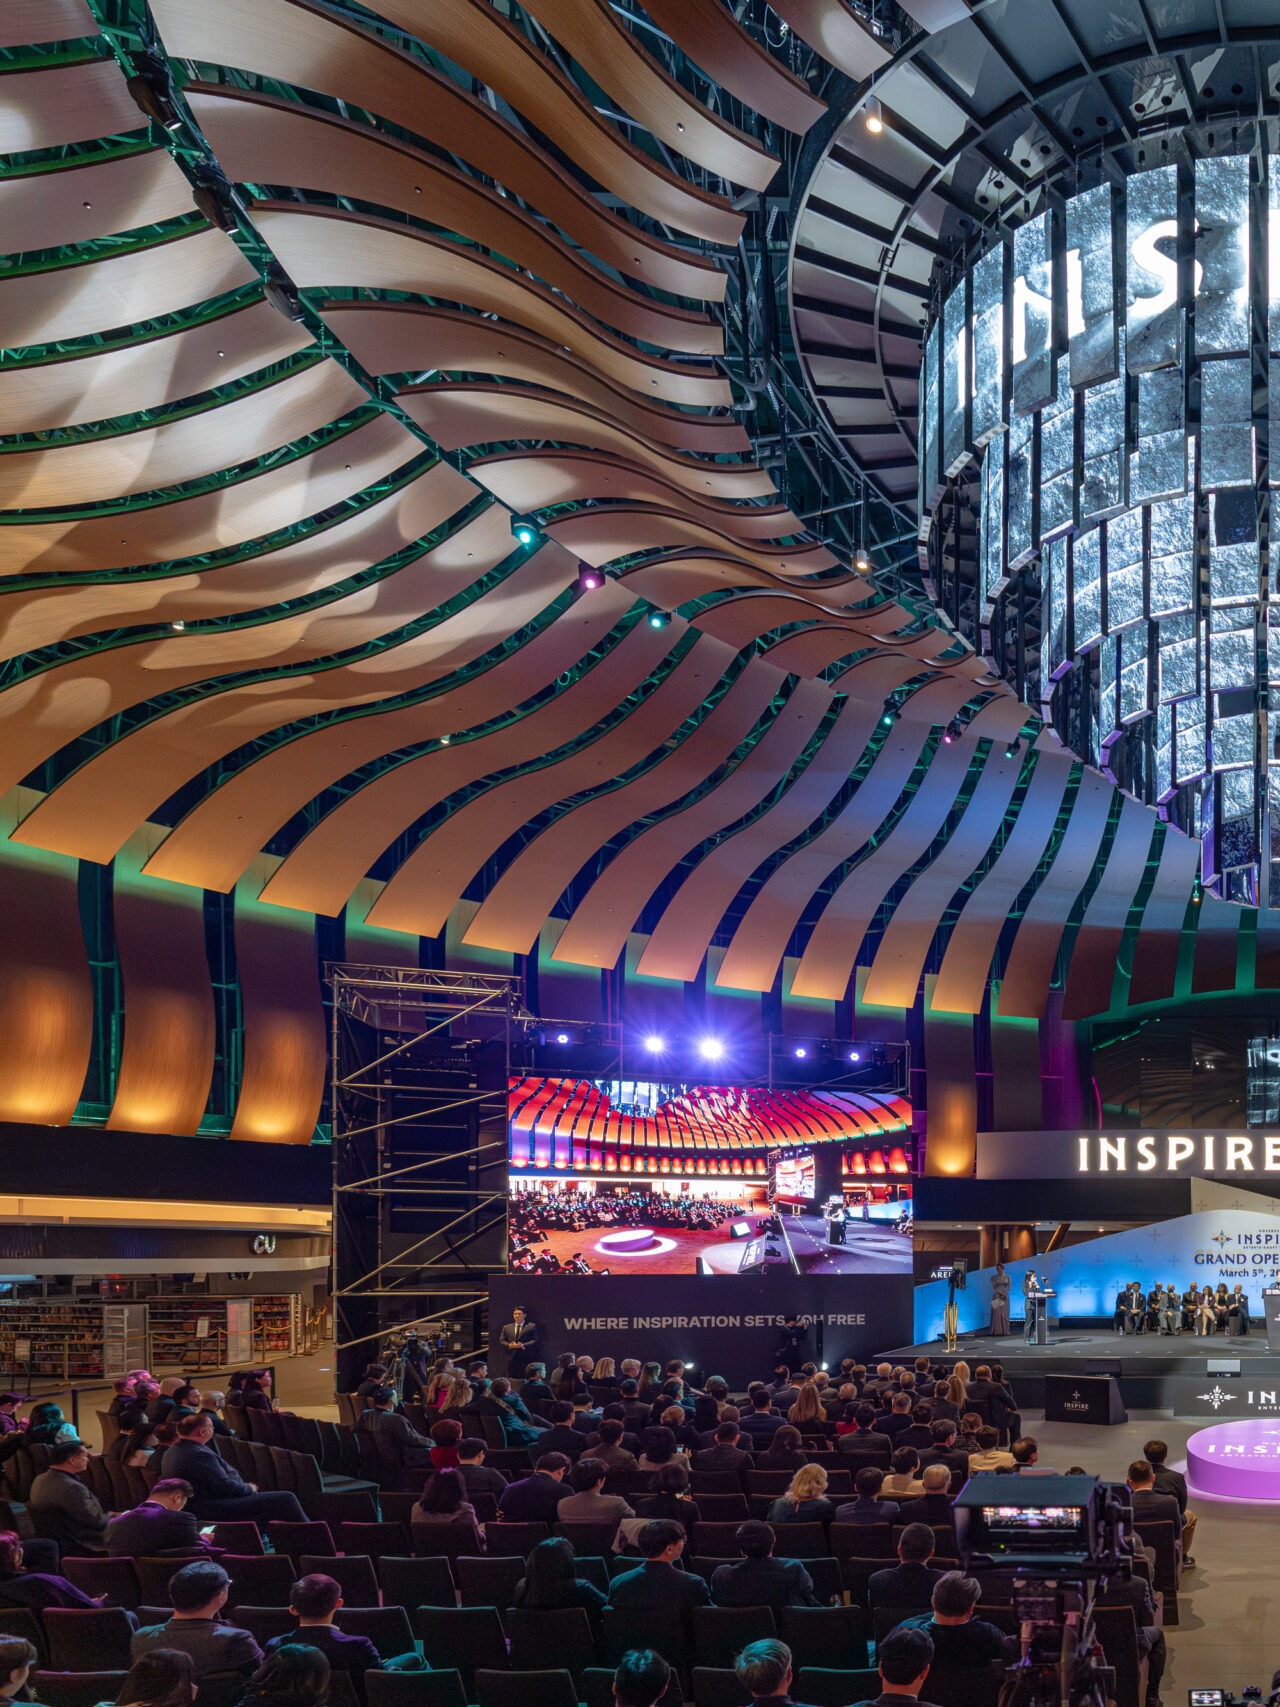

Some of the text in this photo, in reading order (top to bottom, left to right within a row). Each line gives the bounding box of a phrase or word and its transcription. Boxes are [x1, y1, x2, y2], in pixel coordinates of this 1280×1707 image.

[253, 1234, 277, 1254] CU
[1194, 1253, 1247, 1265] GRAND
[930, 1271, 951, 1279] ARE
[1219, 1268, 1249, 1278] March
[564, 1316, 629, 1330] WHERE
[632, 1315, 741, 1329] INSPIRATION
[744, 1314, 786, 1328] SETS
[827, 1313, 866, 1326] FREE
